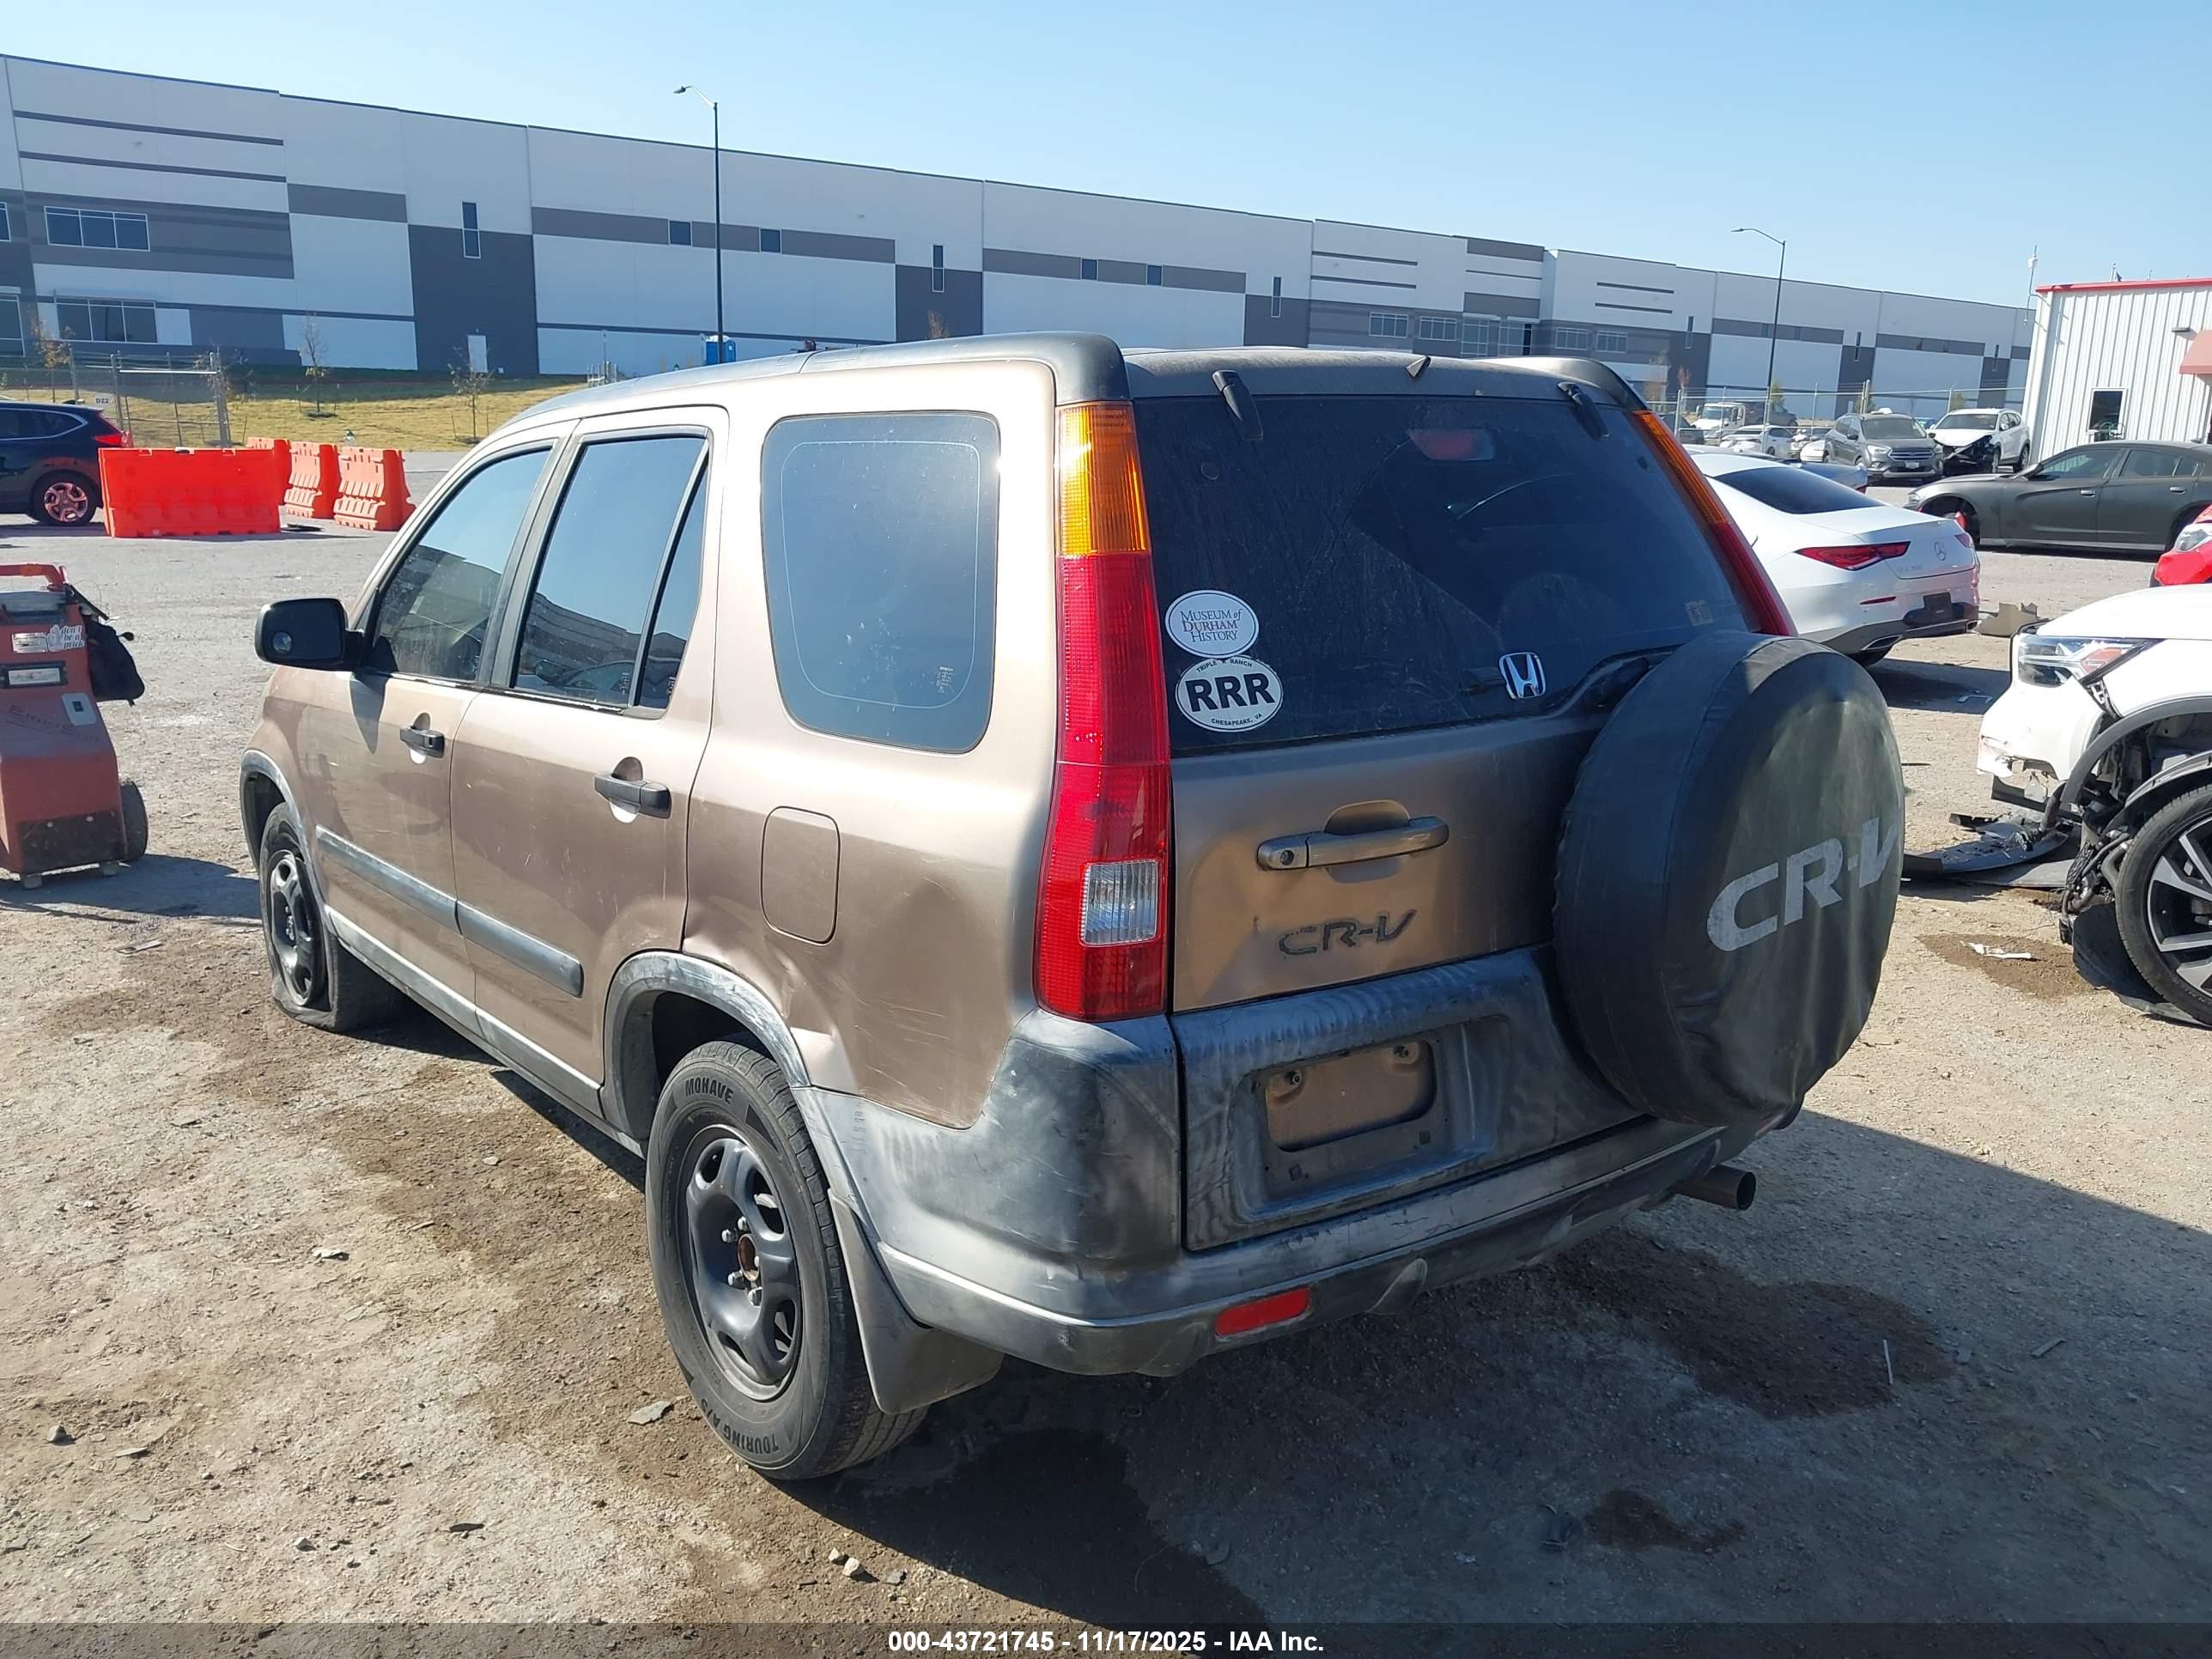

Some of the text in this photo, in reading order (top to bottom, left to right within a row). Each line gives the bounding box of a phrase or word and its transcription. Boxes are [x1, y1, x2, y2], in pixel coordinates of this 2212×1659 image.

[1232, 608, 1243, 621] of
[1196, 659, 1218, 673] TRIPLE
[1230, 659, 1253, 668] RANCH
[1185, 672, 1276, 713] RRR
[1211, 713, 1263, 726] CHESAPEAKE, VA
[1706, 817, 1899, 952] CR-V
[1278, 908, 1417, 956] CR-V
[684, 1077, 735, 1105] MOHAVE
[700, 1397, 780, 1455] TOURING A/S
